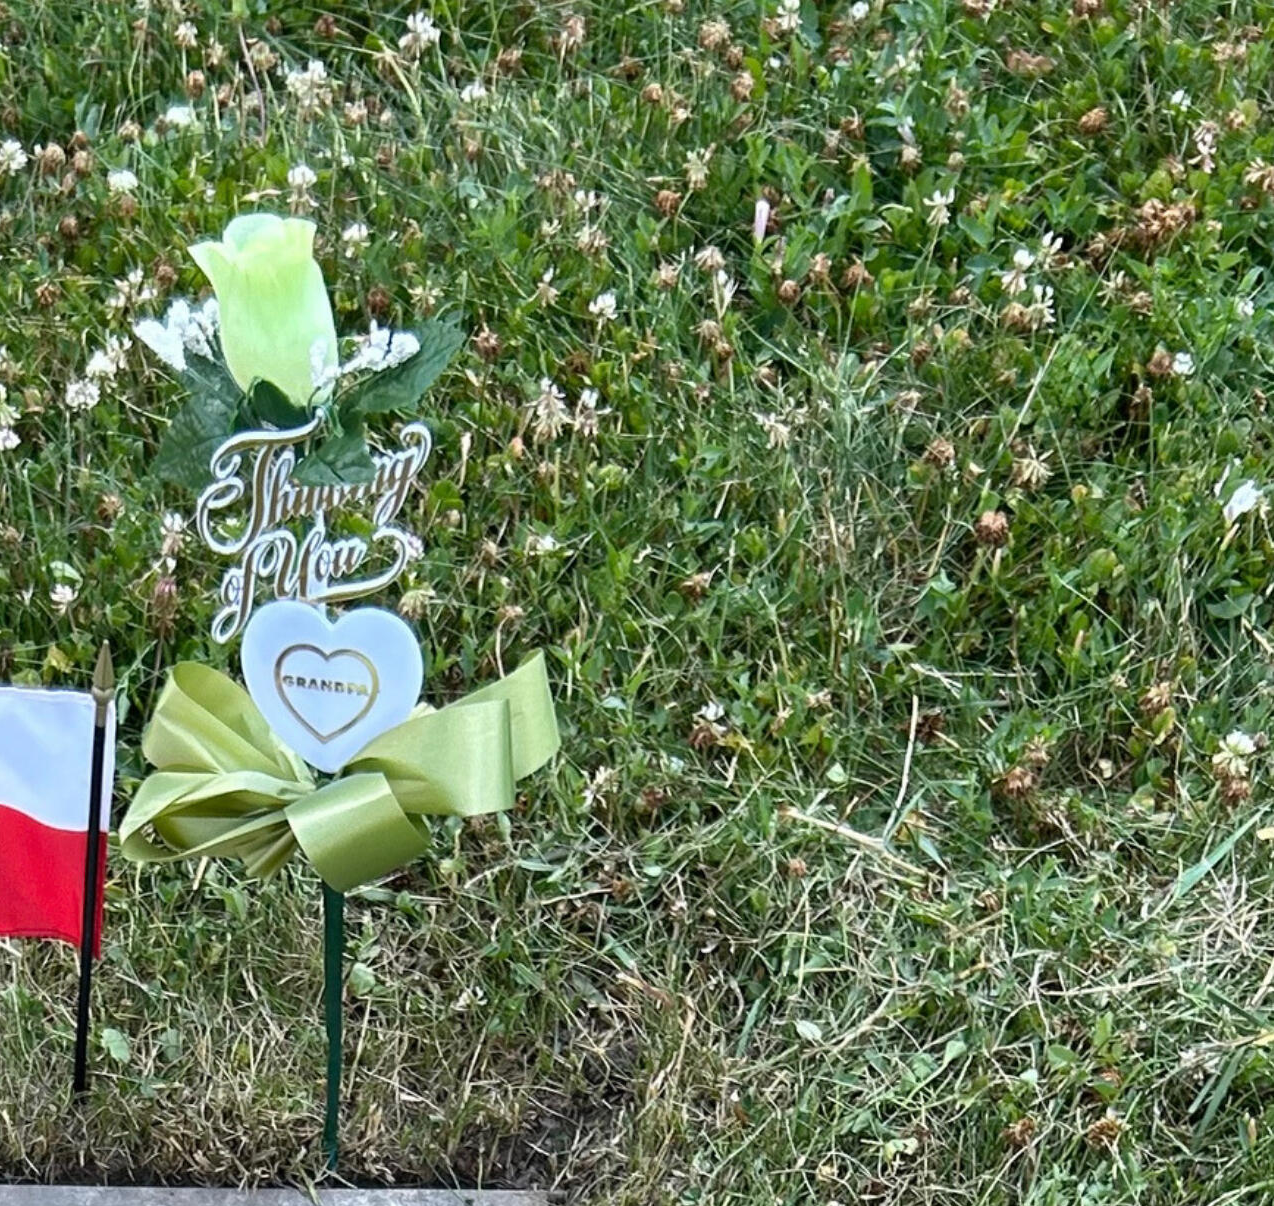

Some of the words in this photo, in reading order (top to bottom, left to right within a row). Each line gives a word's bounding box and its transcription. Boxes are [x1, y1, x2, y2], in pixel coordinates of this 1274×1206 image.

[211, 538, 266, 644] of
[254, 524, 408, 604] You
[282, 675, 369, 697] GRANDPA
